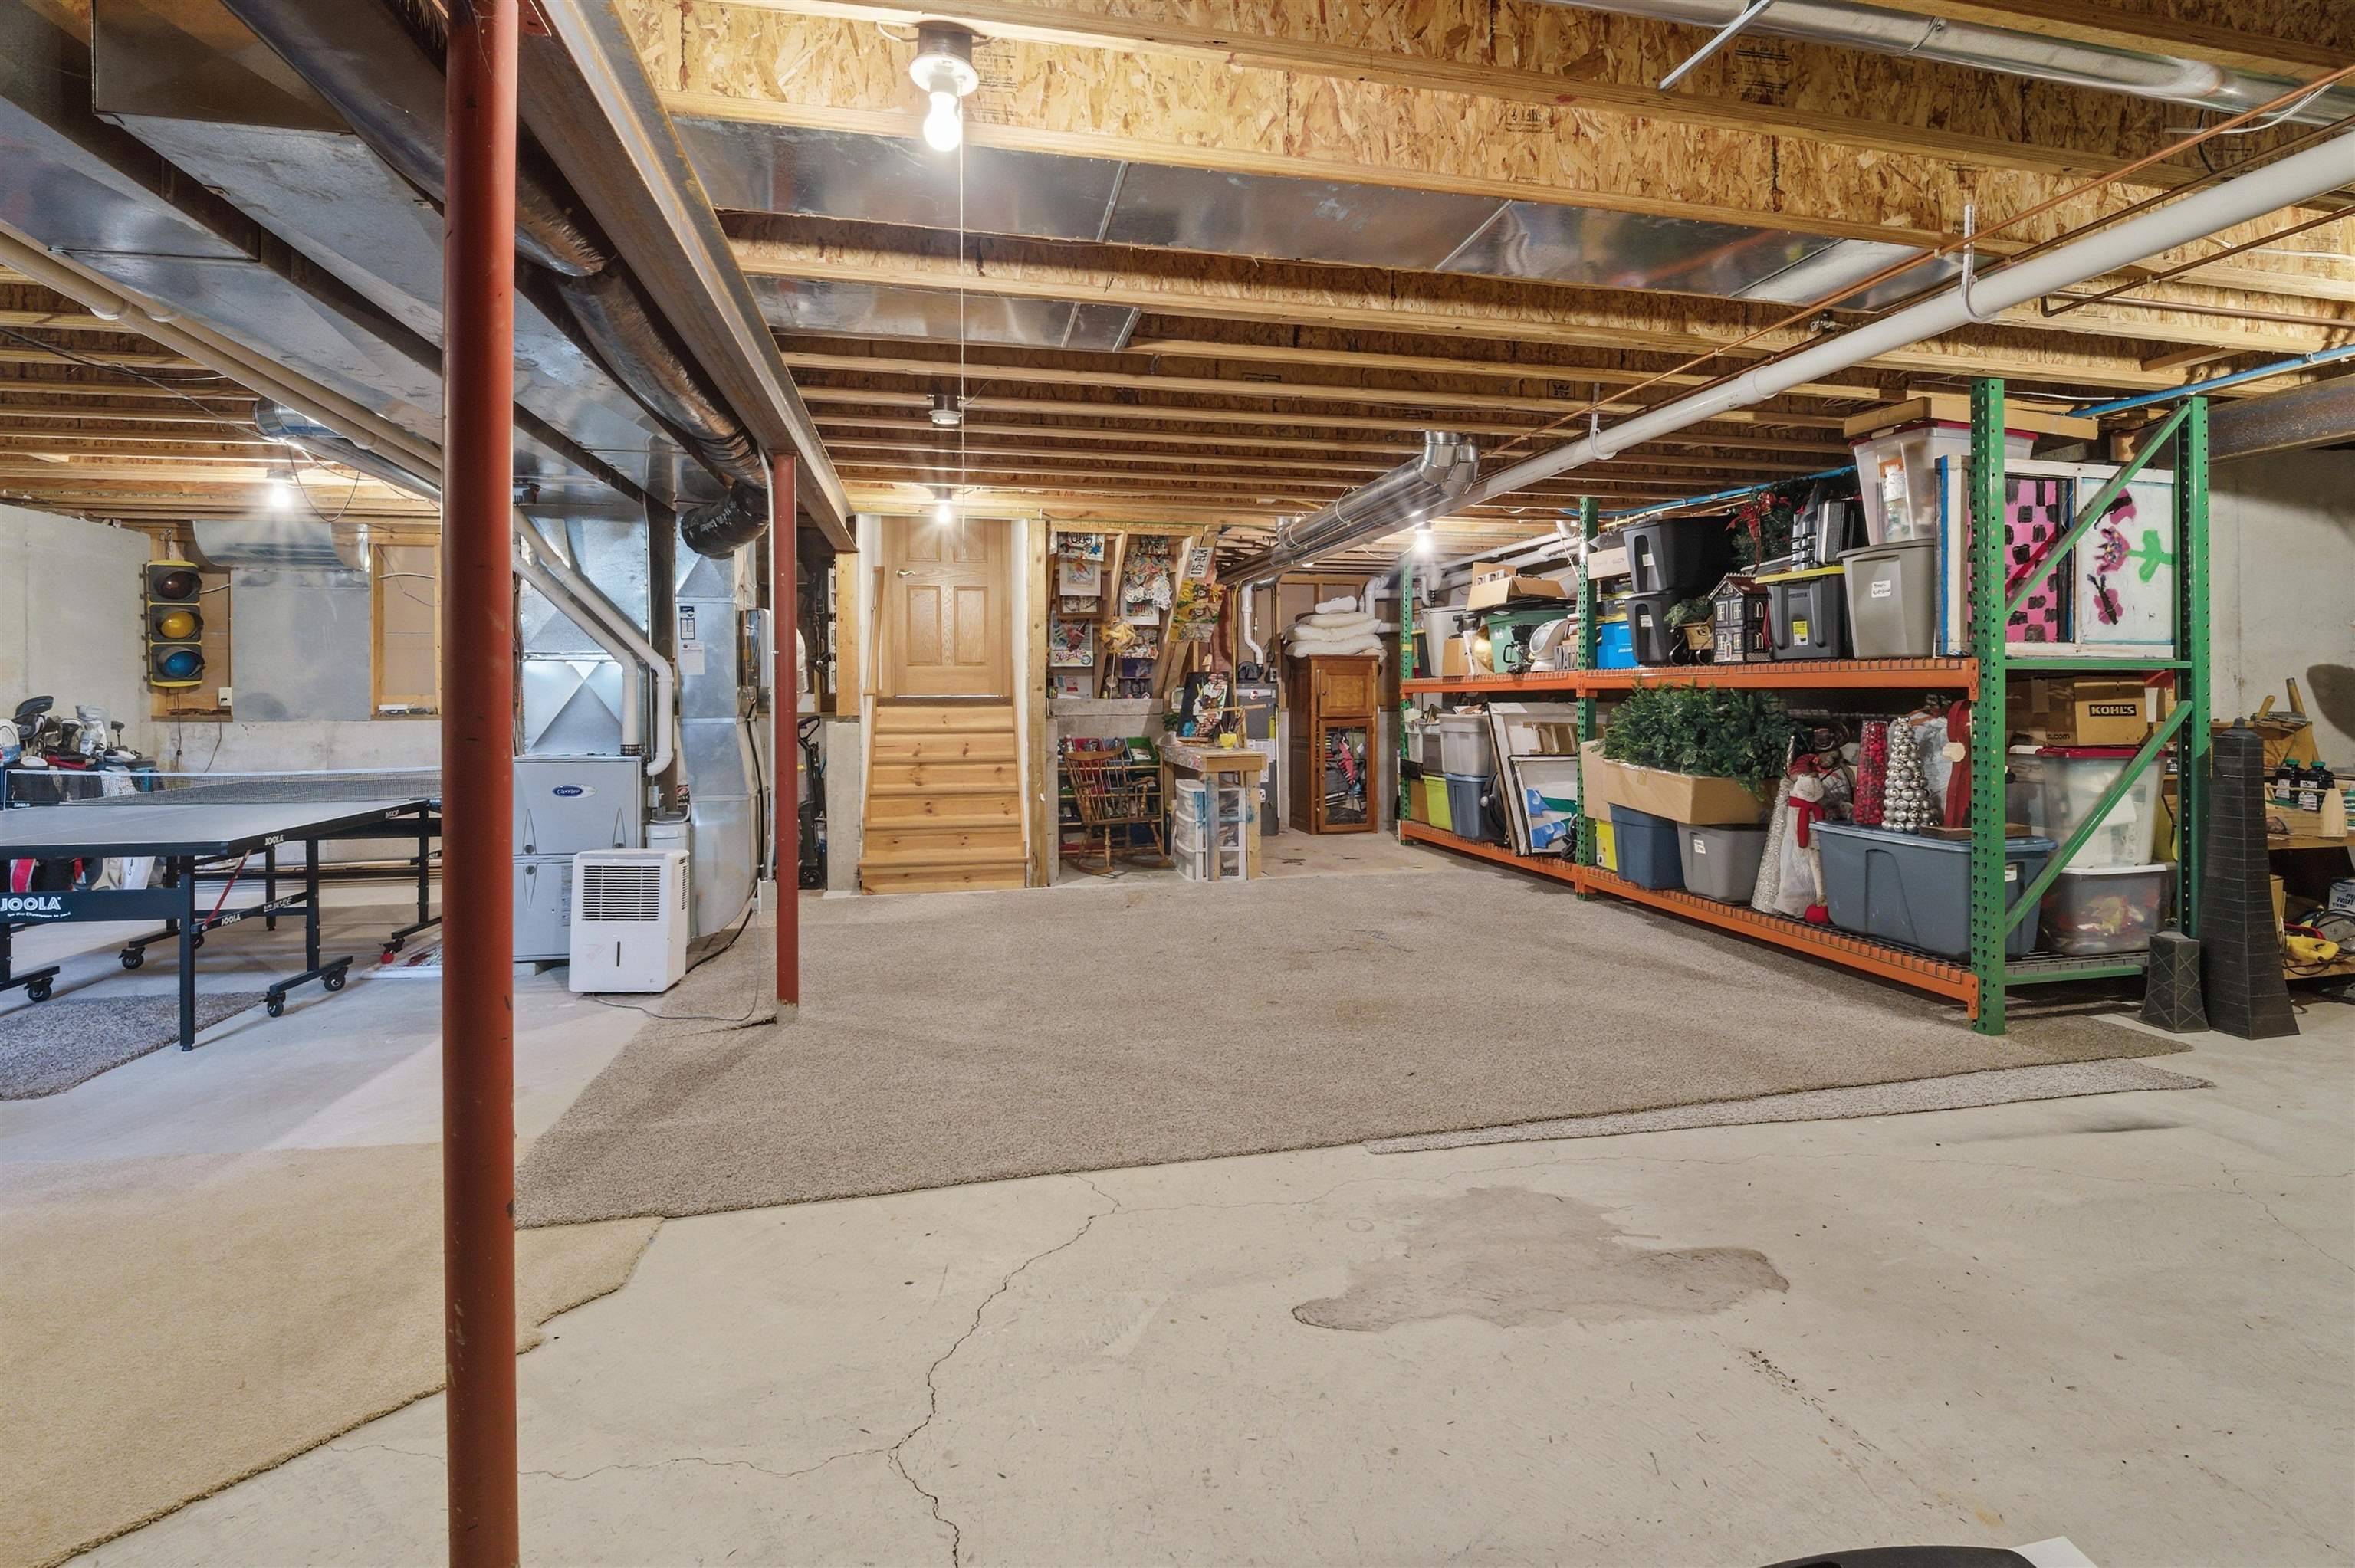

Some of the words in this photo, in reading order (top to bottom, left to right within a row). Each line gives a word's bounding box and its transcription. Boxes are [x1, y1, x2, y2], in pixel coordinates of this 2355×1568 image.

[2091, 706, 2135, 715] KOHL'S
[0, 897, 61, 911] JOOLA
[221, 913, 241, 927] JOOLA
